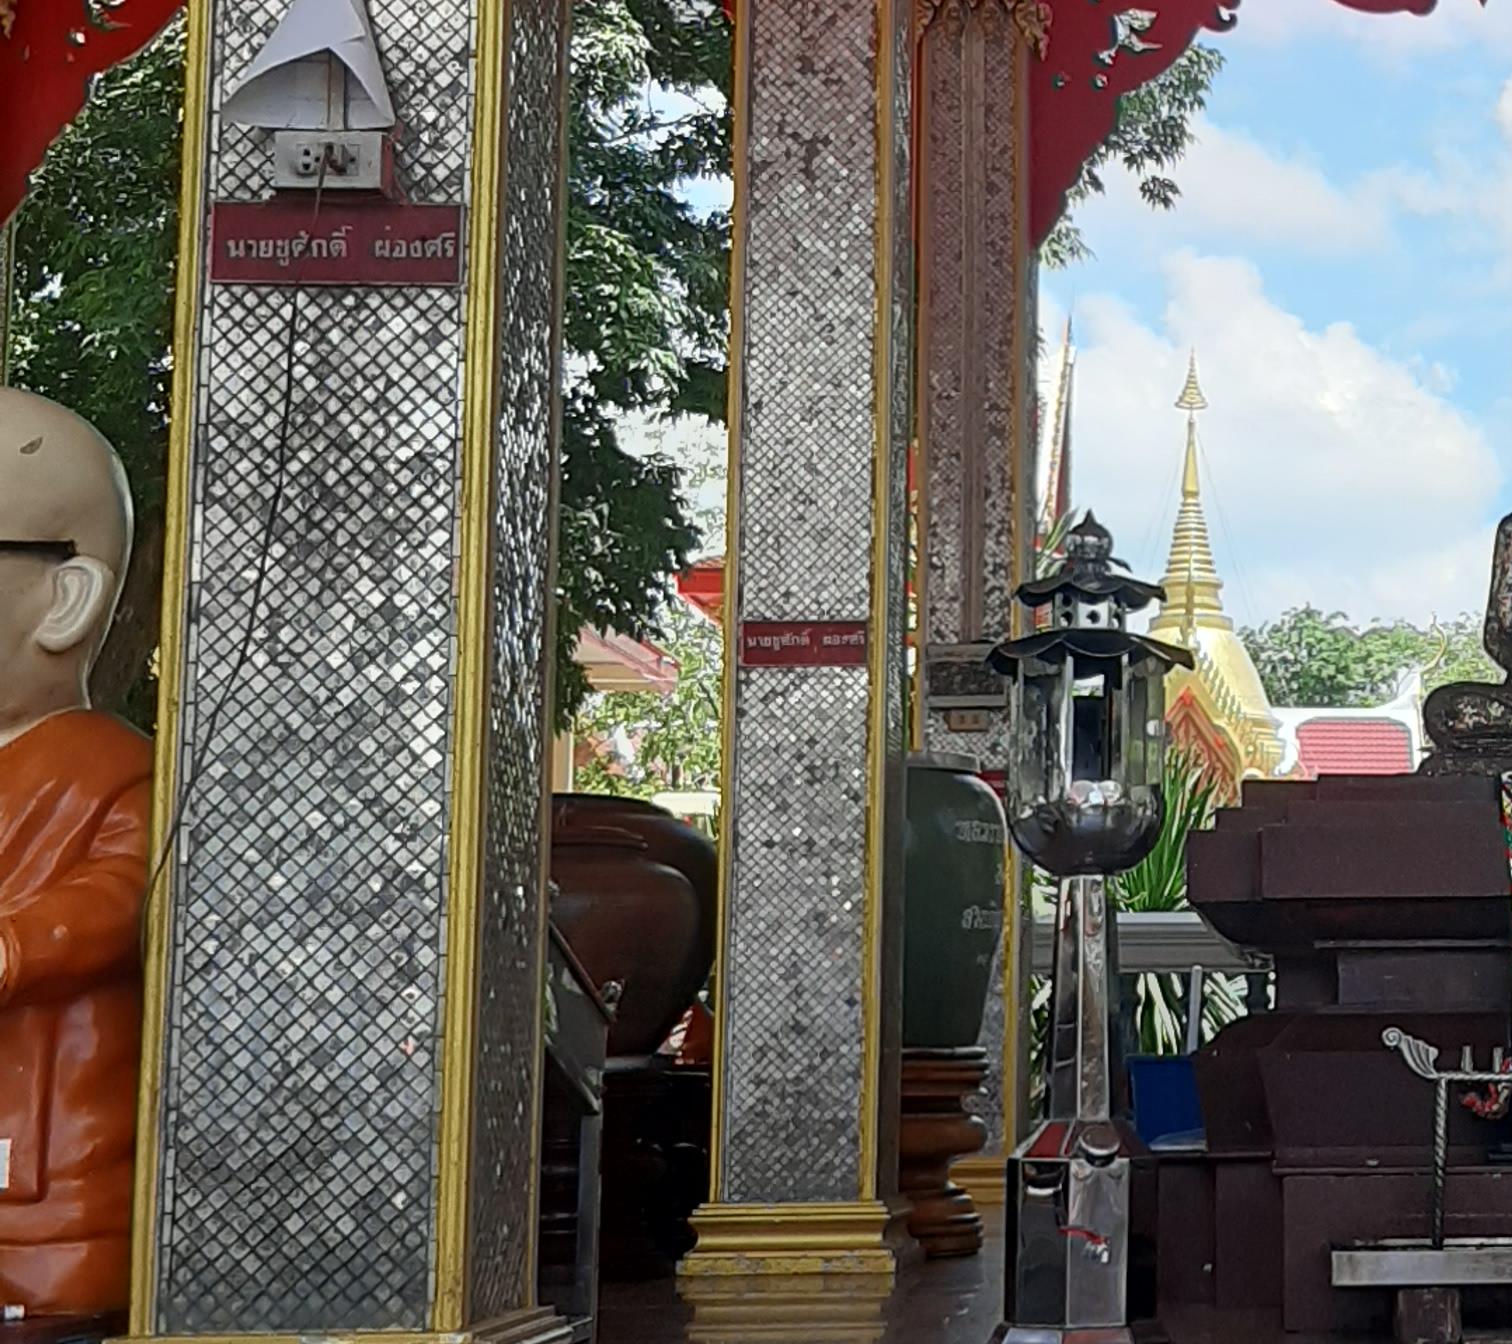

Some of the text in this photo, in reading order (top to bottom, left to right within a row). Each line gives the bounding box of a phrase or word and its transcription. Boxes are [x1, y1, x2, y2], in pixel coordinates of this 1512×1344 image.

[227, 225, 456, 267] นายชูศักดิ์ ผ่องศรี
